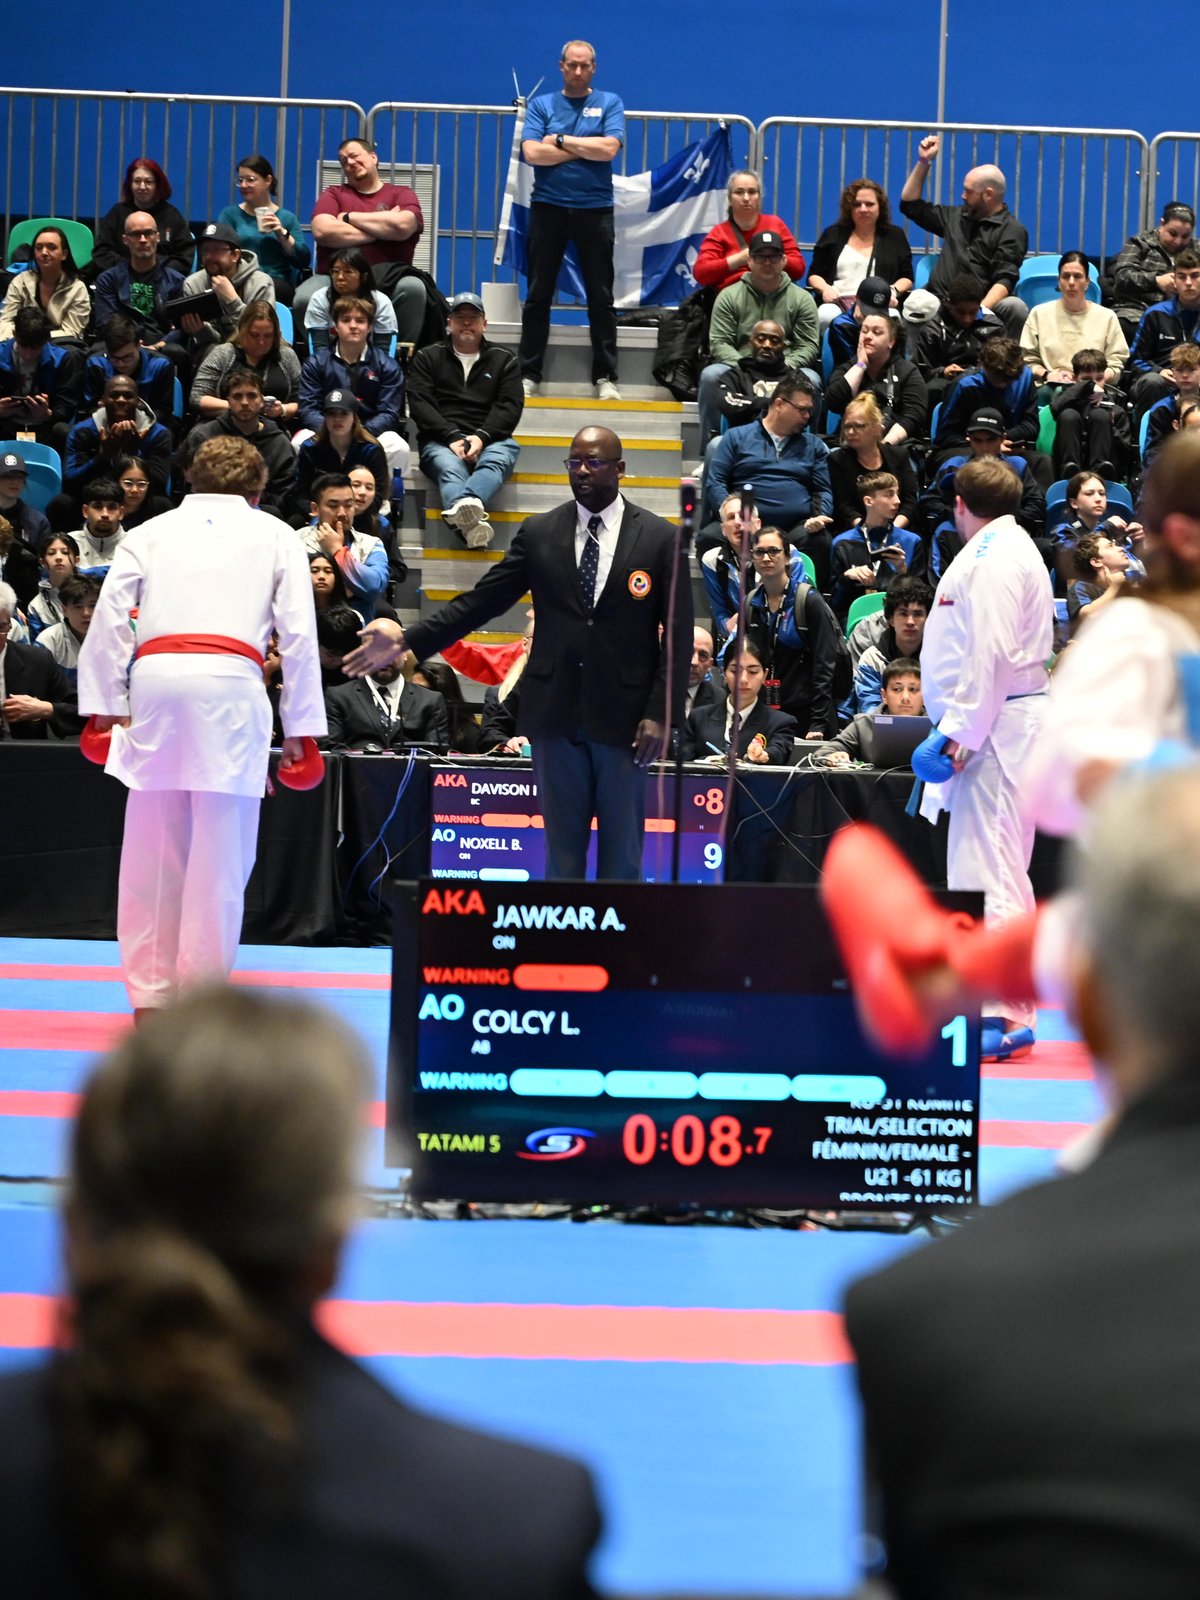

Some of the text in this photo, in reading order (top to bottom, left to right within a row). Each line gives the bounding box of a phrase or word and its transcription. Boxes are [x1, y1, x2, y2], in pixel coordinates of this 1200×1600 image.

[434, 774, 467, 787] AKA
[471, 783, 530, 796] DAVISON
[434, 814, 480, 824] WARNING
[432, 828, 456, 842] AO
[460, 837, 523, 850] NOXELL B.
[704, 843, 723, 869] 9
[432, 869, 478, 879] WARNING
[421, 888, 487, 915] AKA
[492, 904, 626, 931] JAWKAR A.
[492, 935, 516, 950] ON
[422, 967, 511, 985] WARNING
[418, 993, 465, 1021] AO
[472, 1009, 580, 1035] COLCY L.
[941, 1015, 967, 1067] 1
[420, 1071, 508, 1091] WARNING
[824, 1116, 973, 1137] TRIAL/SELECTION
[417, 1132, 501, 1154] TATAMI 5
[812, 1137, 960, 1162] FÉMININ/FEMALE
[864, 1167, 898, 1186] U21
[903, 1168, 931, 1187] -61
[936, 1169, 962, 1187] KG
